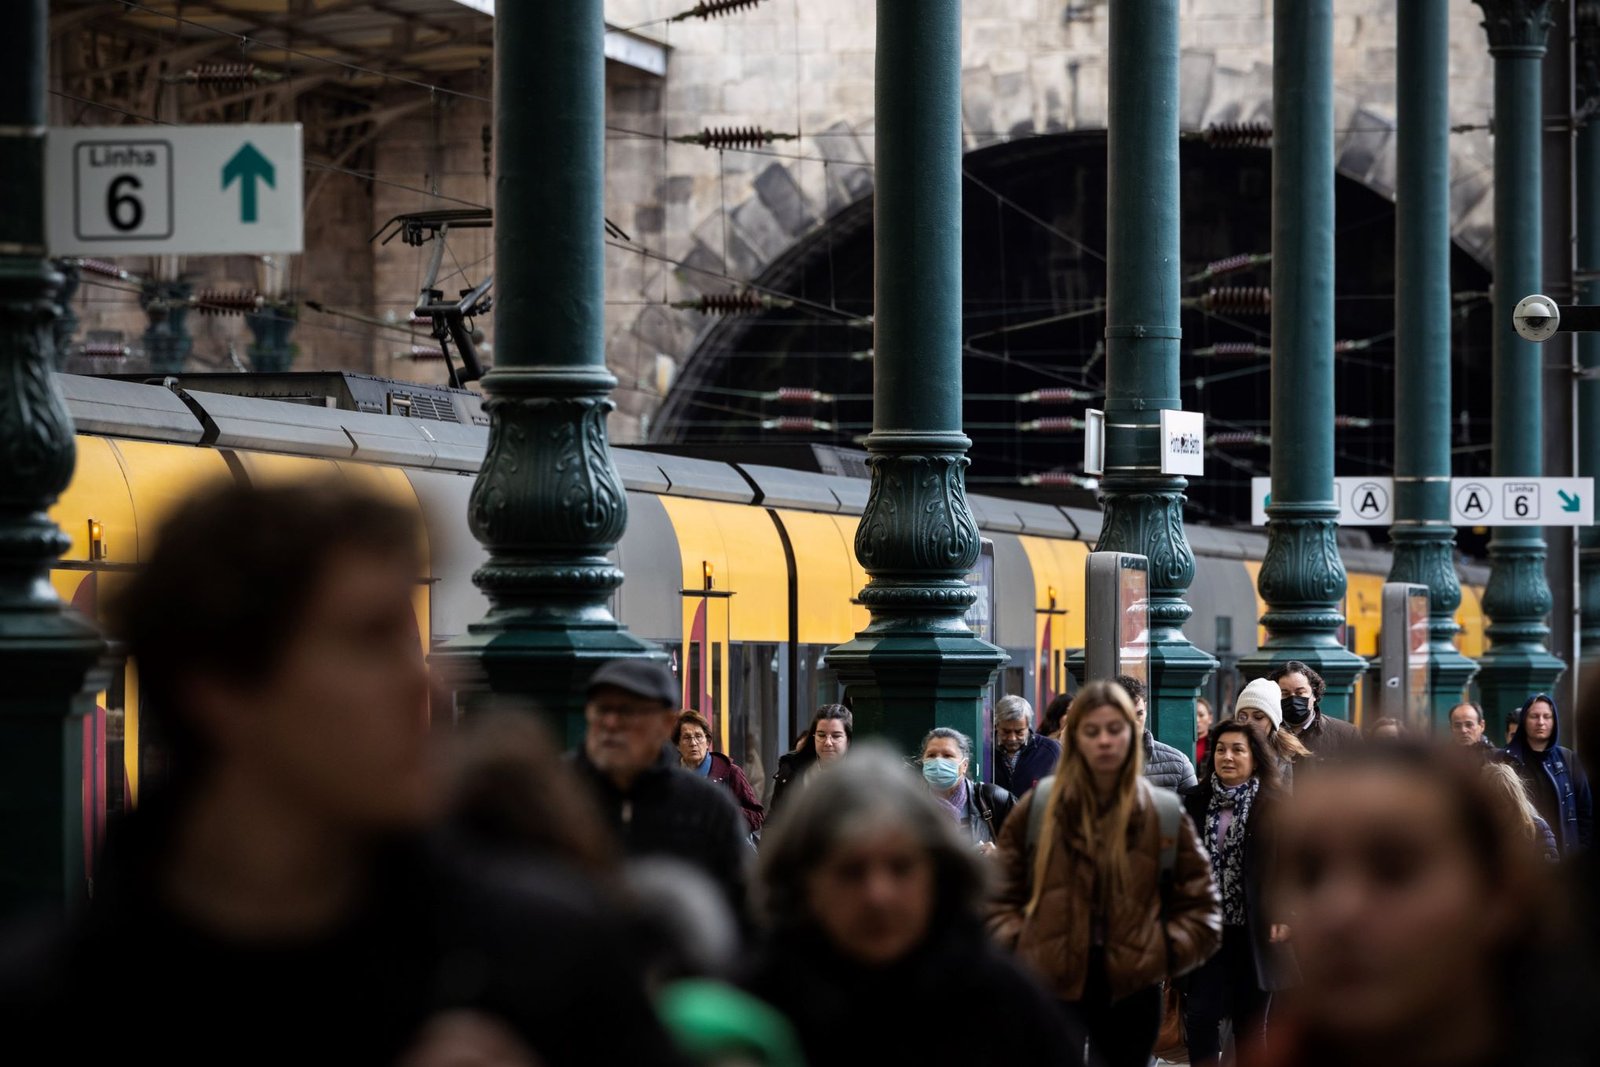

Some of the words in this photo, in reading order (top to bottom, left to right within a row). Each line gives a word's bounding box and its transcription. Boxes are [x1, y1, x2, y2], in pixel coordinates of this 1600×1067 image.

[89, 145, 156, 167] Linha
[106, 173, 144, 232] 6
[1508, 485, 1534, 493] Linha
[1360, 491, 1379, 512] A
[1464, 491, 1483, 513] A
[1515, 495, 1529, 516] 6
